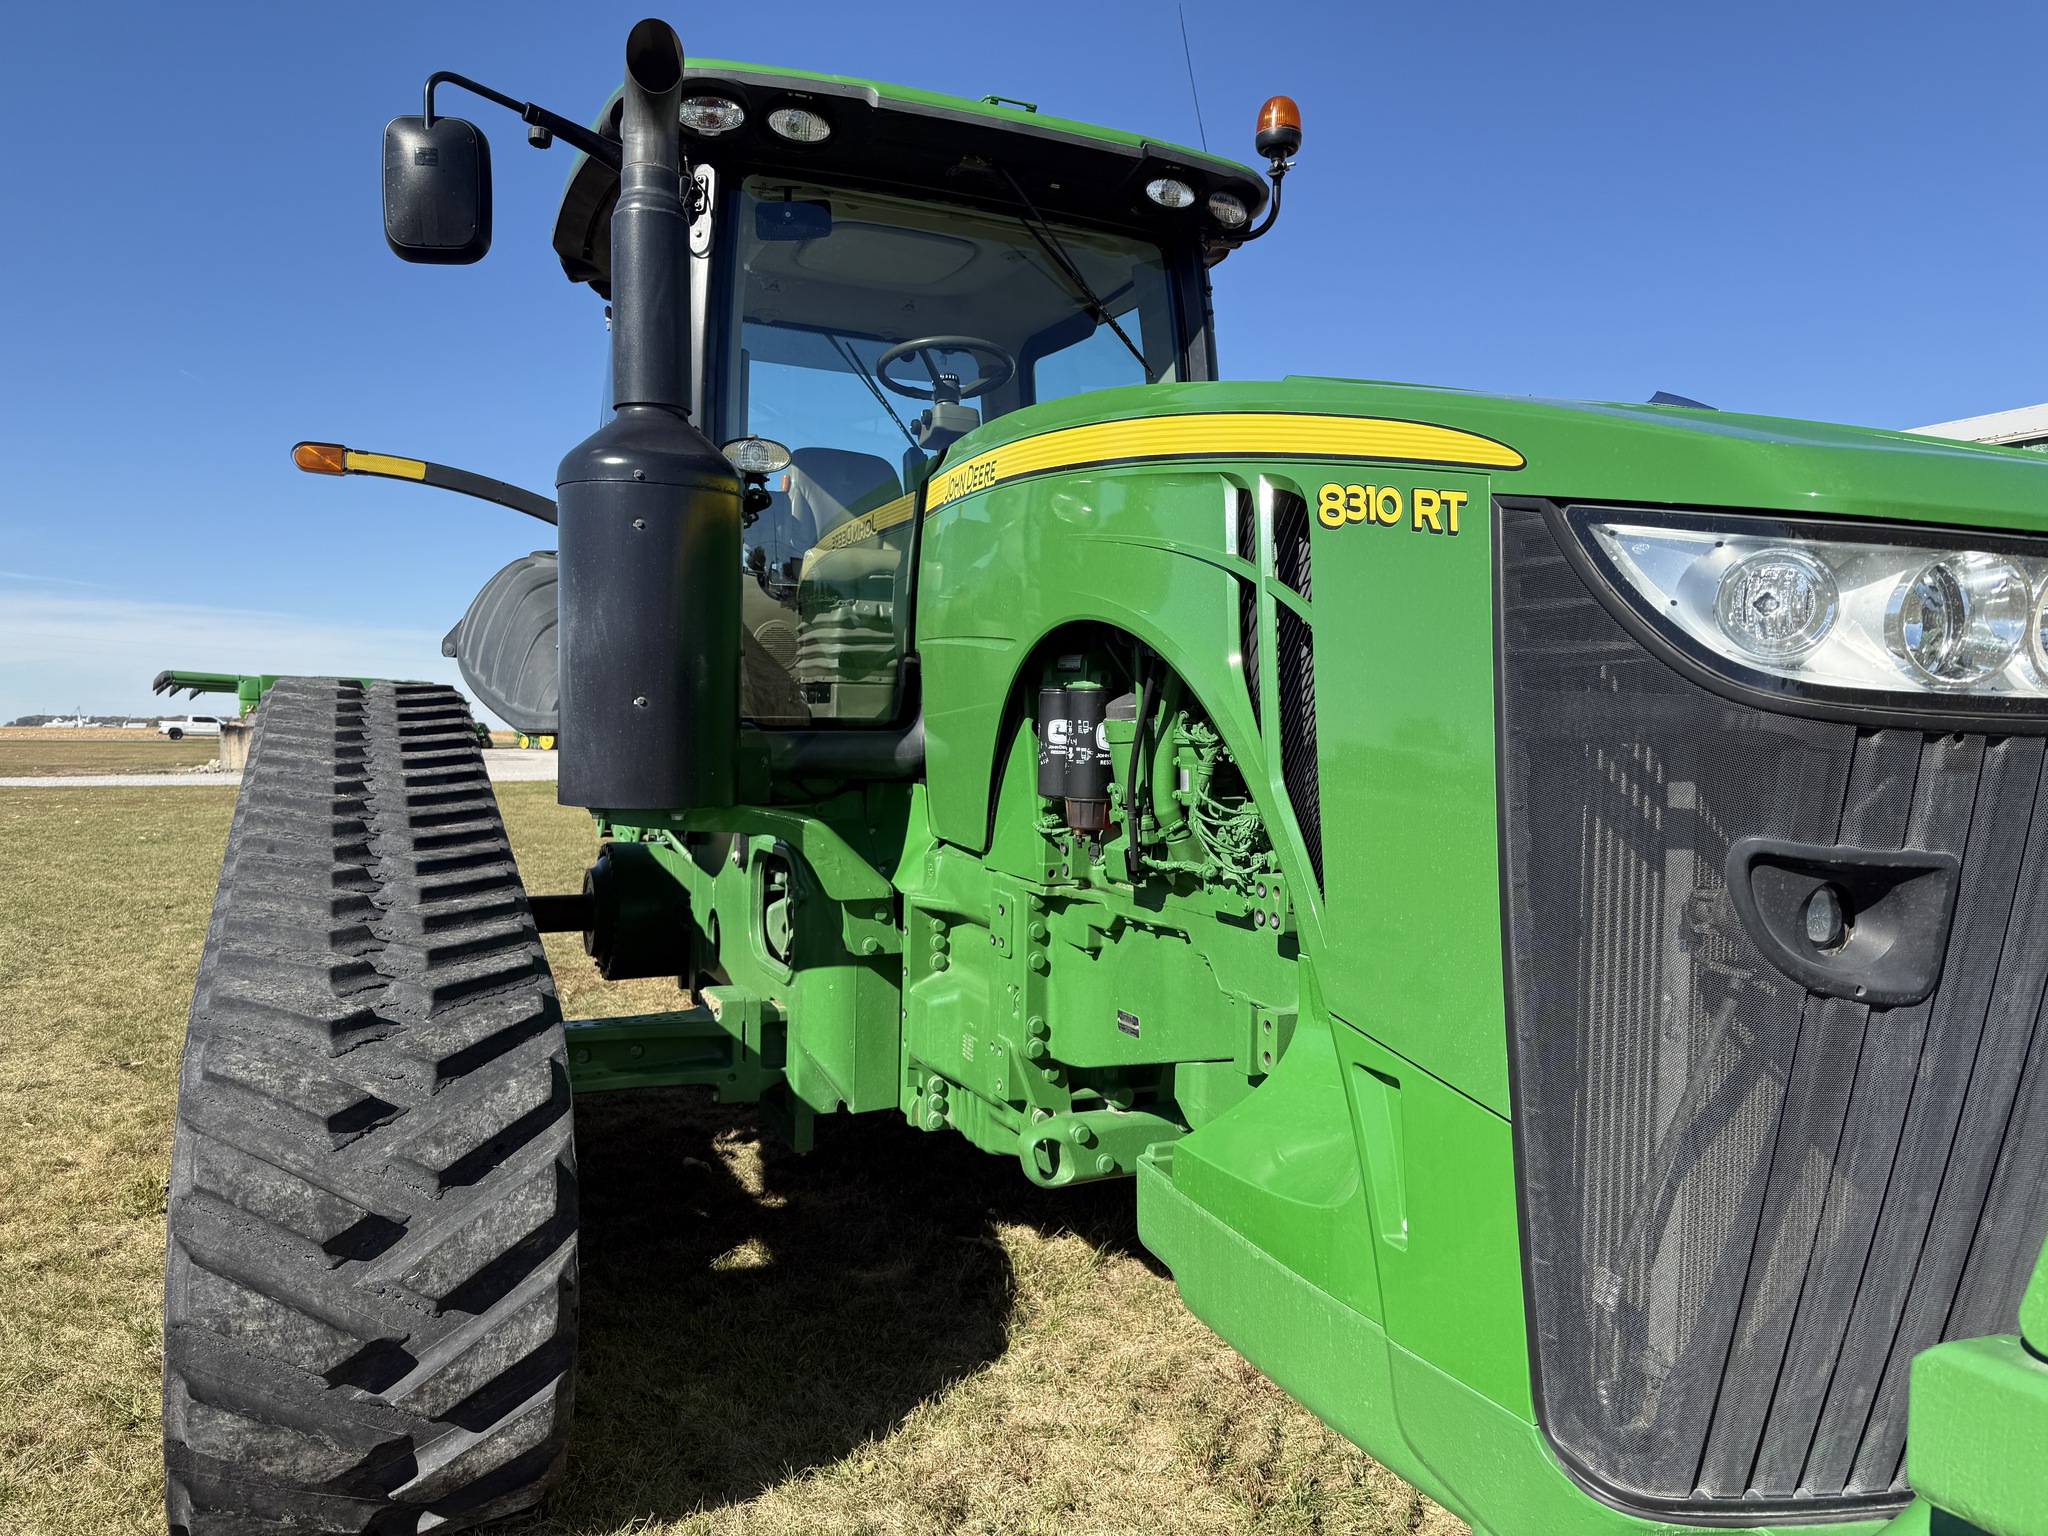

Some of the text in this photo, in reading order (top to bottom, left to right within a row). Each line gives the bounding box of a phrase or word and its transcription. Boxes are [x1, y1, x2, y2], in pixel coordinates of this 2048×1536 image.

[944, 460, 997, 501] JOHN DEERE
[1317, 482, 1468, 536] 8310 RT
